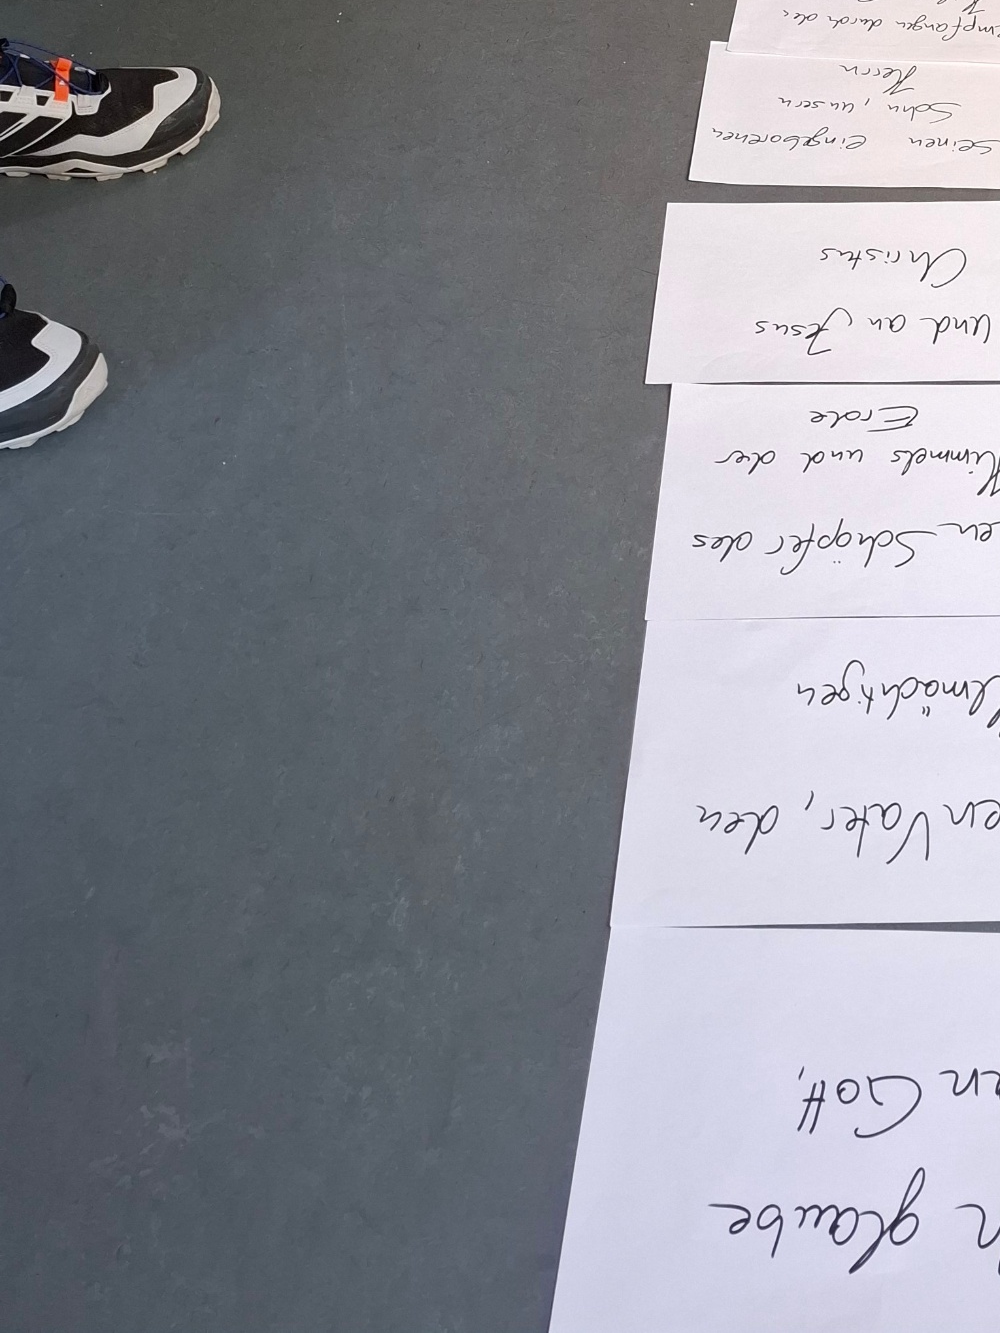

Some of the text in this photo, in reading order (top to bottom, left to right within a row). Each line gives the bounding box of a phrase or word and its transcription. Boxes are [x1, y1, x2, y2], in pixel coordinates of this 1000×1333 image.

[827, 14, 883, 31] durch
[839, 65, 917, 96] Herrn
[778, 97, 854, 113] unsern
[711, 127, 1000, 155] seinen eingeborenen
[821, 248, 967, 288] Christus
[754, 308, 852, 356] Jesus
[867, 315, 906, 333] an
[809, 406, 918, 432] Erde
[714, 450, 776, 474] der
[800, 450, 864, 473] und
[692, 532, 753, 563] des
[764, 518, 937, 576] Schöpfer
[696, 805, 779, 855] den
[804, 791, 929, 865] Vater,
[796, 1066, 922, 1138] Gott,
[708, 1168, 925, 1274] glaube
